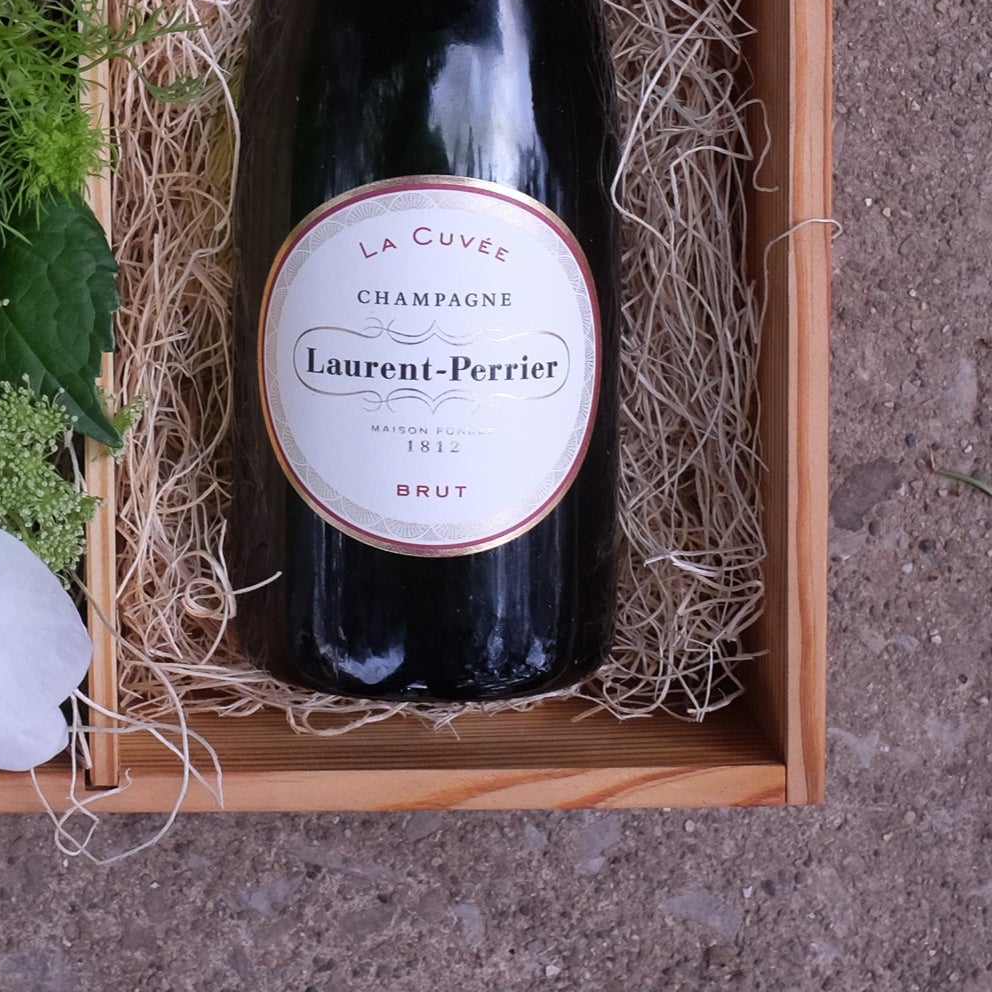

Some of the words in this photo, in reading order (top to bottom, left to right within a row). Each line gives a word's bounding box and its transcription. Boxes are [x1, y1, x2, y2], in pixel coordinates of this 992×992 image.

[359, 238, 397, 259] LA
[357, 289, 512, 307] CHAMPAGNE
[305, 347, 559, 382] Laurent-Perrier
[370, 424, 428, 435] MAISON
[406, 440, 460, 453] 1812
[396, 484, 467, 498] BRUT
